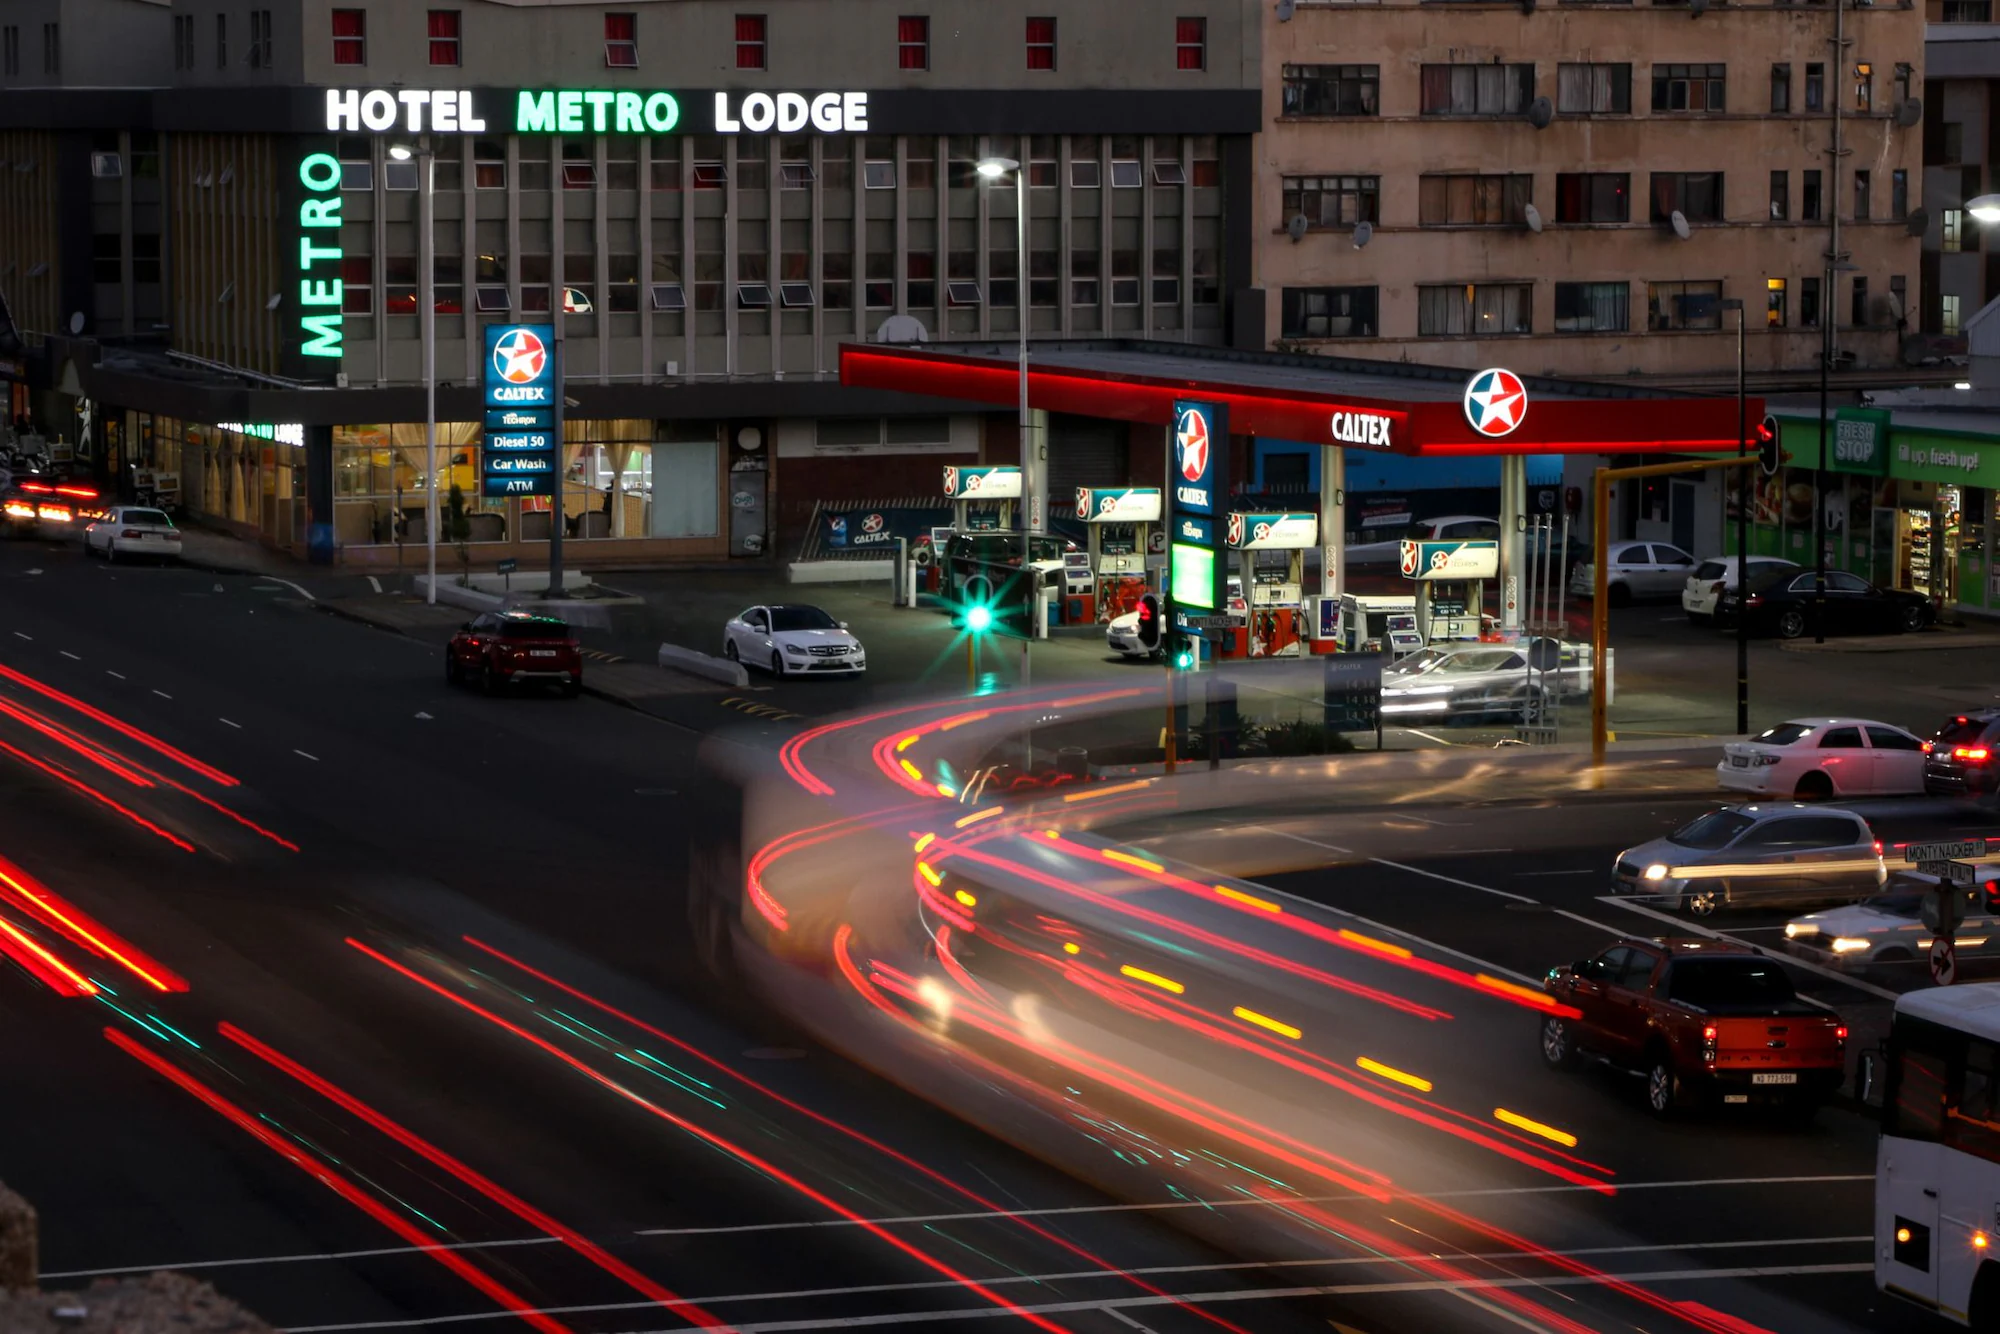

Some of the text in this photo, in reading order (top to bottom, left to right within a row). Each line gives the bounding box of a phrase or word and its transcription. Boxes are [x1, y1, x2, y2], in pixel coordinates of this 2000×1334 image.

[326, 89, 868, 133] HOTEL METRO LODGE
[300, 153, 343, 357] METRO
[493, 387, 545, 401] CALTEX
[502, 415, 536, 425] TECHRON
[1332, 412, 1391, 447] CALTEX
[1837, 420, 1876, 439] FRESH
[494, 436, 545, 448] Diesel 50
[1836, 441, 1874, 462] STOP
[1930, 447, 1957, 466] fresh
[1960, 452, 1979, 471] up!
[493, 458, 546, 470] Car Wash
[506, 481, 534, 492] ATM
[1177, 487, 1209, 507] CALTEX
[854, 532, 890, 545] CALTEX
[1909, 845, 1937, 860] MONTY
[1939, 842, 1974, 858] NAICKER
